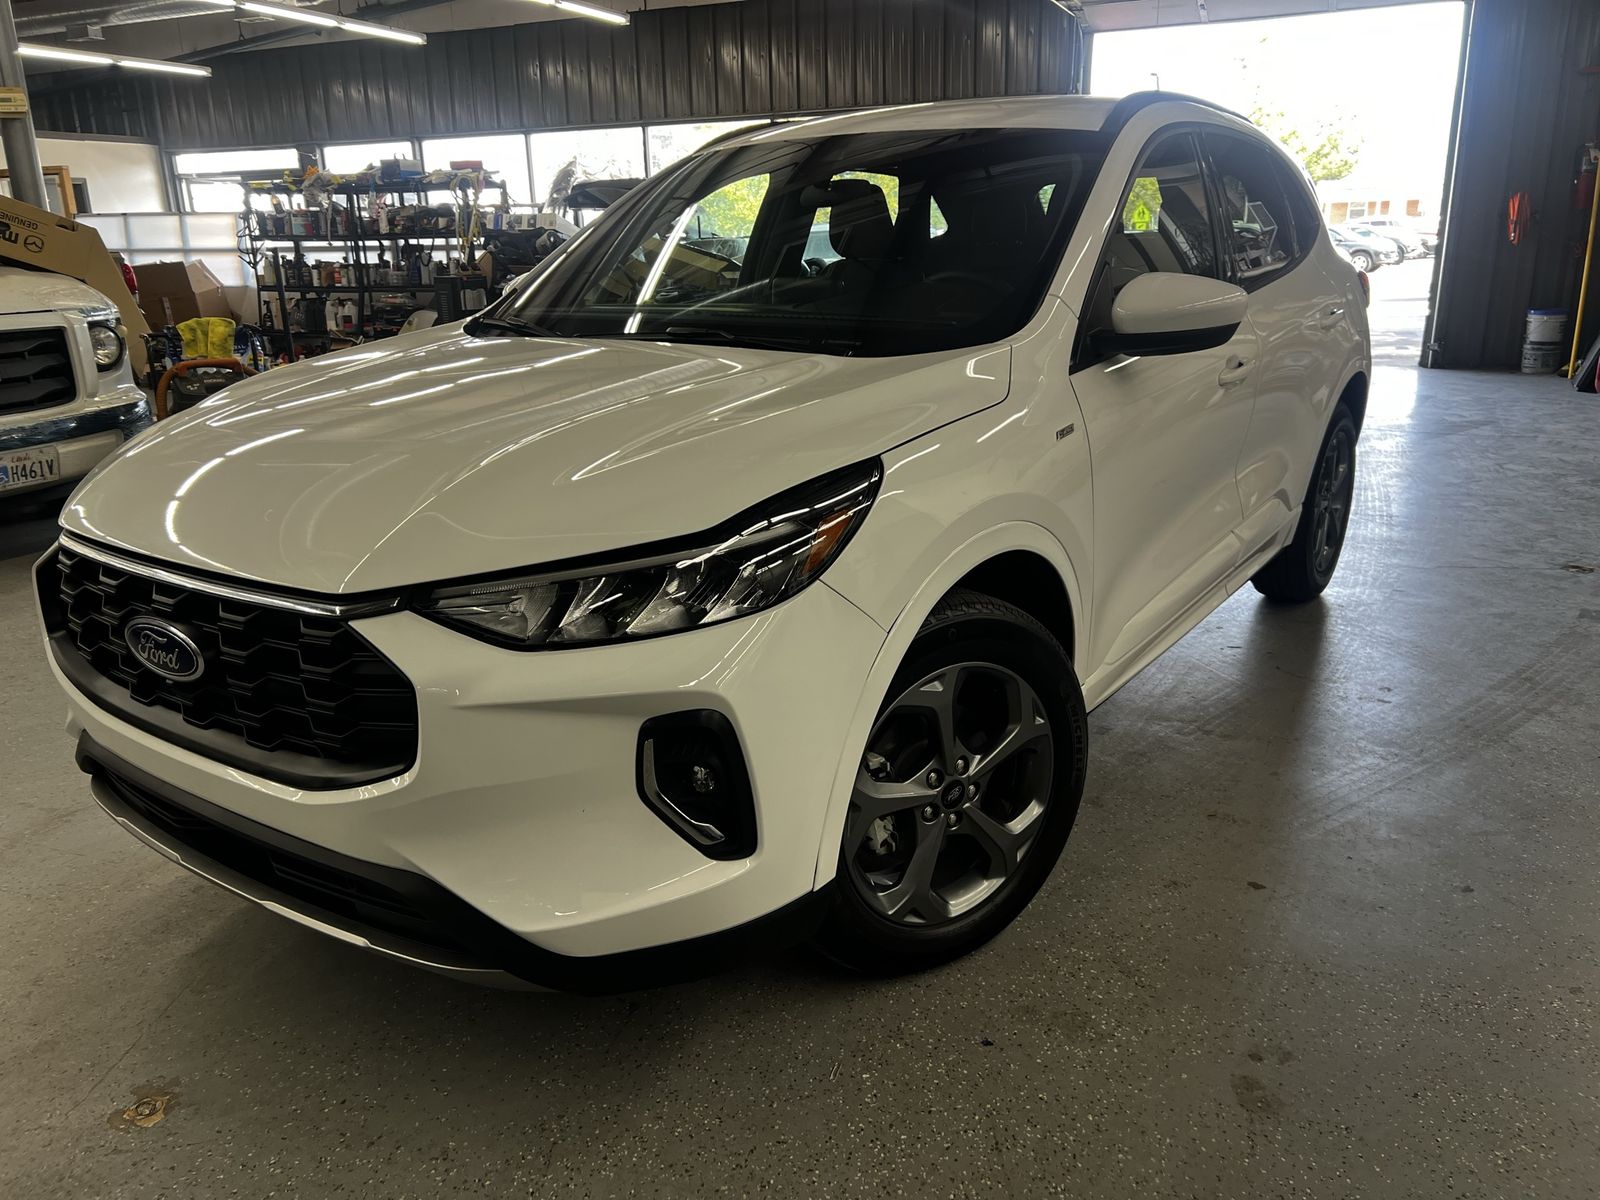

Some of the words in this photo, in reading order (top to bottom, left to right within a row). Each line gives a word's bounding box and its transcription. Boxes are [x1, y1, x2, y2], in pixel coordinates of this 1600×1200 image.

[0, 211, 38, 230] GENUINE
[10, 459, 54, 482] H461V
[138, 630, 180, 670] Ford
